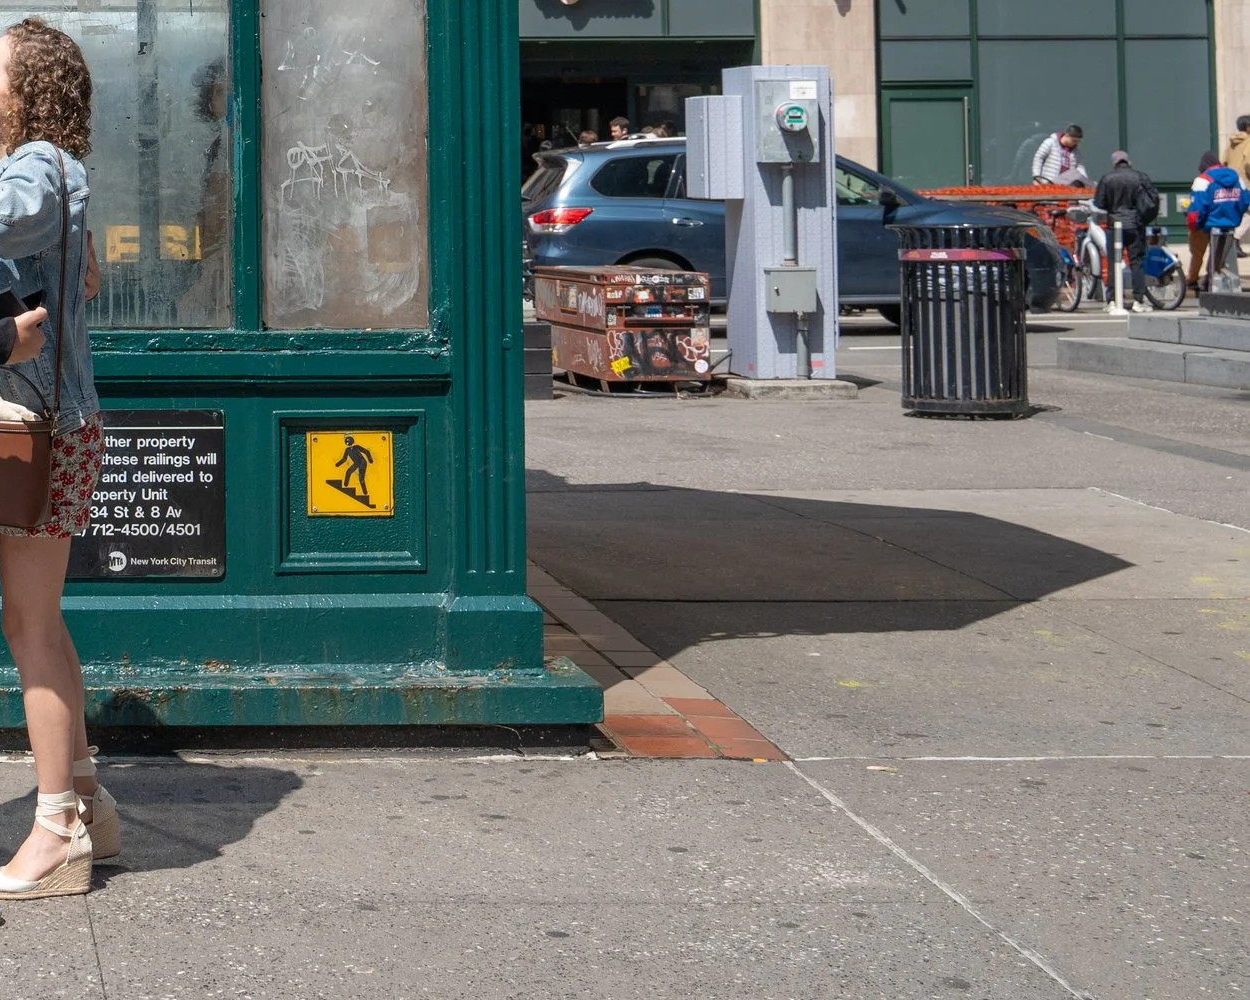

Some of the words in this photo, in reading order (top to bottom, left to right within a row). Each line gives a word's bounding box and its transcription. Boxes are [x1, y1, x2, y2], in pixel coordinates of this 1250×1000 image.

[105, 436, 132, 448] ther
[136, 436, 195, 450] property
[101, 453, 138, 465] these
[143, 453, 190, 468] railings
[196, 453, 217, 465] will
[102, 471, 127, 483] and
[132, 471, 194, 483] delivered
[199, 472, 213, 483] to
[91, 490, 137, 503] operty
[141, 489, 168, 500] Unit
[90, 506, 108, 518] 34
[113, 506, 129, 518] St
[134, 506, 145, 518] &
[150, 506, 161, 518] 8
[166, 506, 182, 518] Av
[91, 524, 201, 536] 712-4500/4501
[130, 557, 149, 565] New
[150, 557, 169, 565] York
[169, 557, 187, 567] City
[188, 557, 217, 565] Transit
